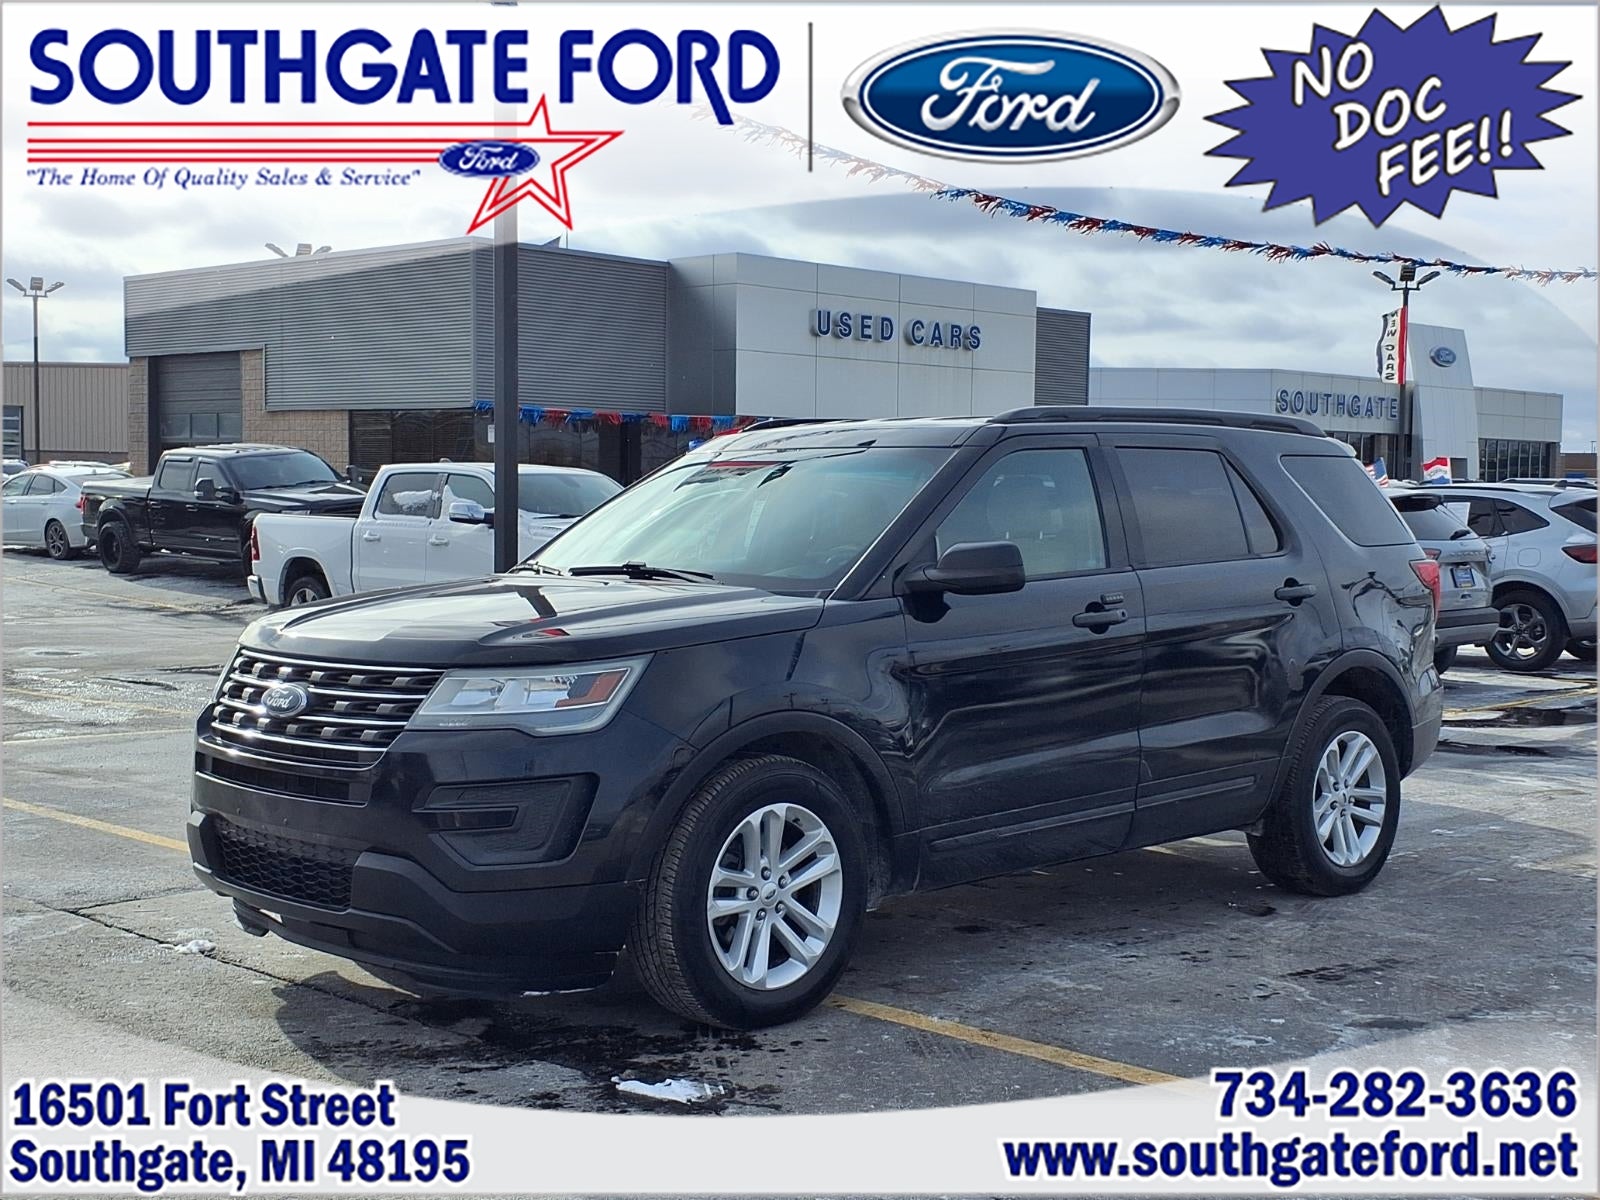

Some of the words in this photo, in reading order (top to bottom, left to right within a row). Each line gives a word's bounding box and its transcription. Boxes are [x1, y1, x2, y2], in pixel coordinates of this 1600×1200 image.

[816, 309, 894, 342] USED
[911, 320, 982, 350] CARS
[1277, 388, 1398, 418] SOUTHGATE
[266, 688, 293, 708] Ford
